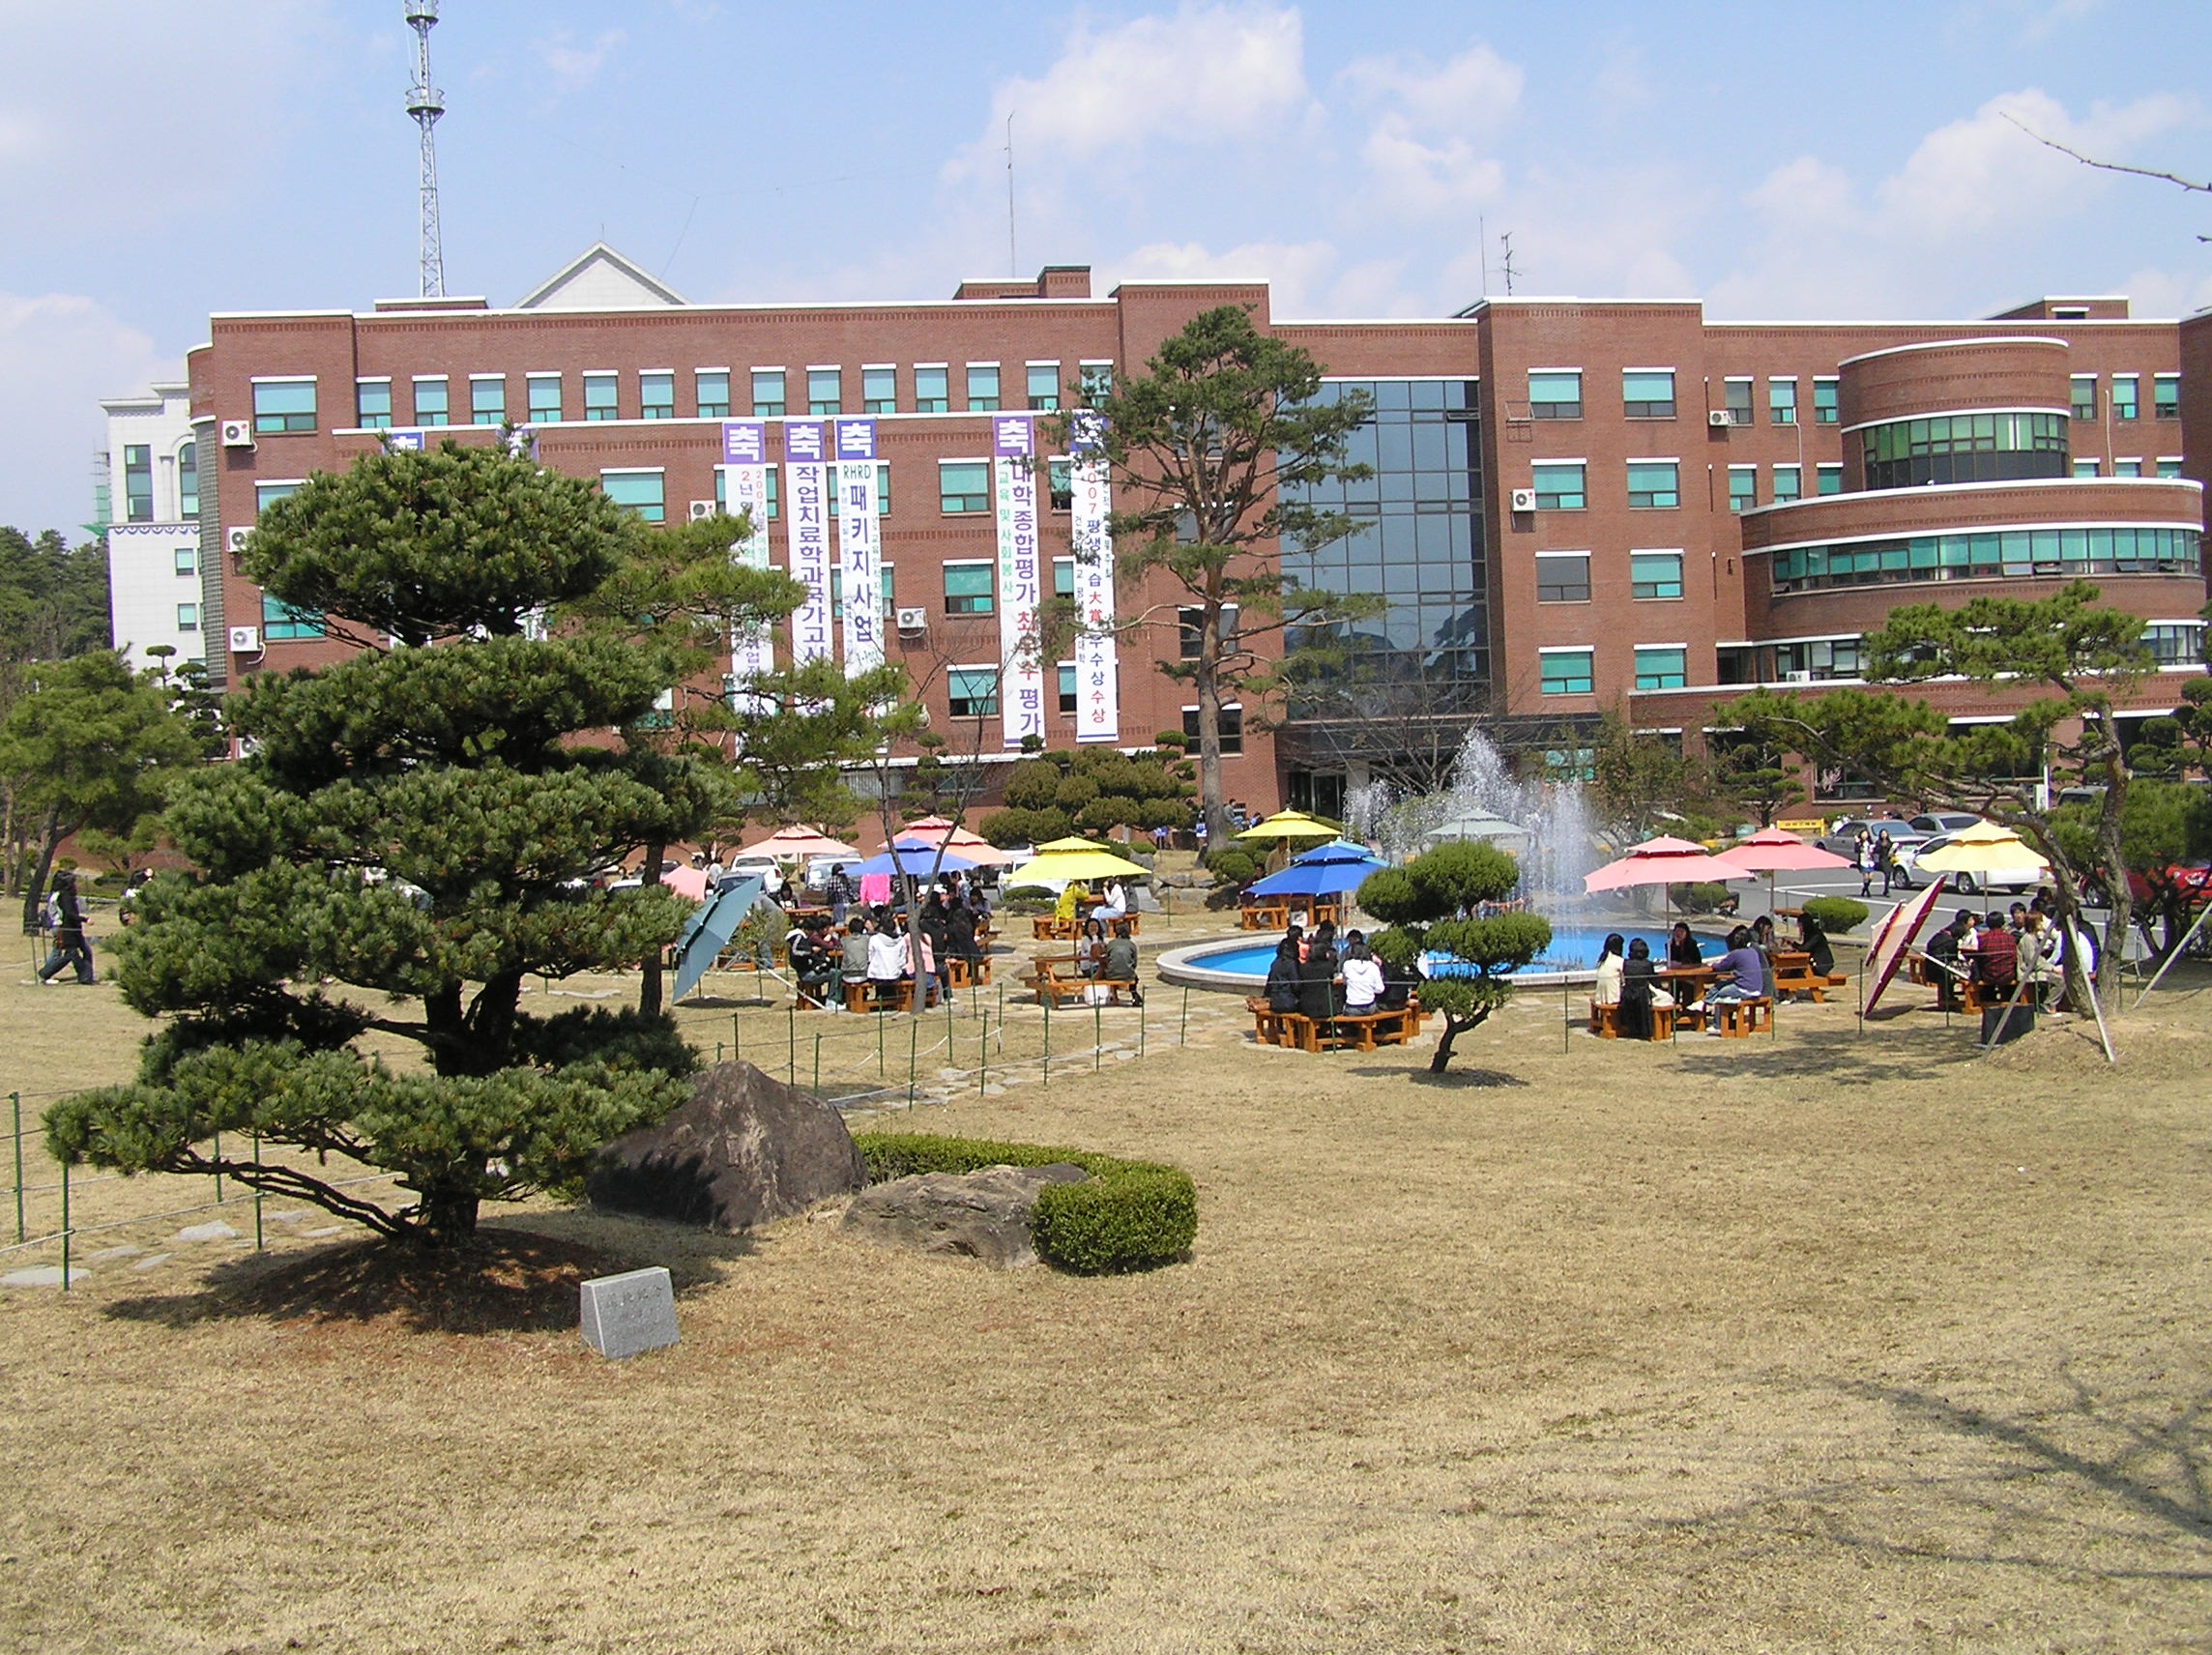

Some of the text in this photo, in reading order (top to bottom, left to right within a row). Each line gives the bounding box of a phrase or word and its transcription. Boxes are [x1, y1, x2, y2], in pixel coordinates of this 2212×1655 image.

[729, 426, 760, 462] 축
[789, 425, 821, 460] 축
[841, 422, 872, 457] 축
[999, 420, 1029, 454] 축
[843, 464, 871, 479] RHRD
[1012, 458, 1041, 736] 대학종합평가 최수 평가
